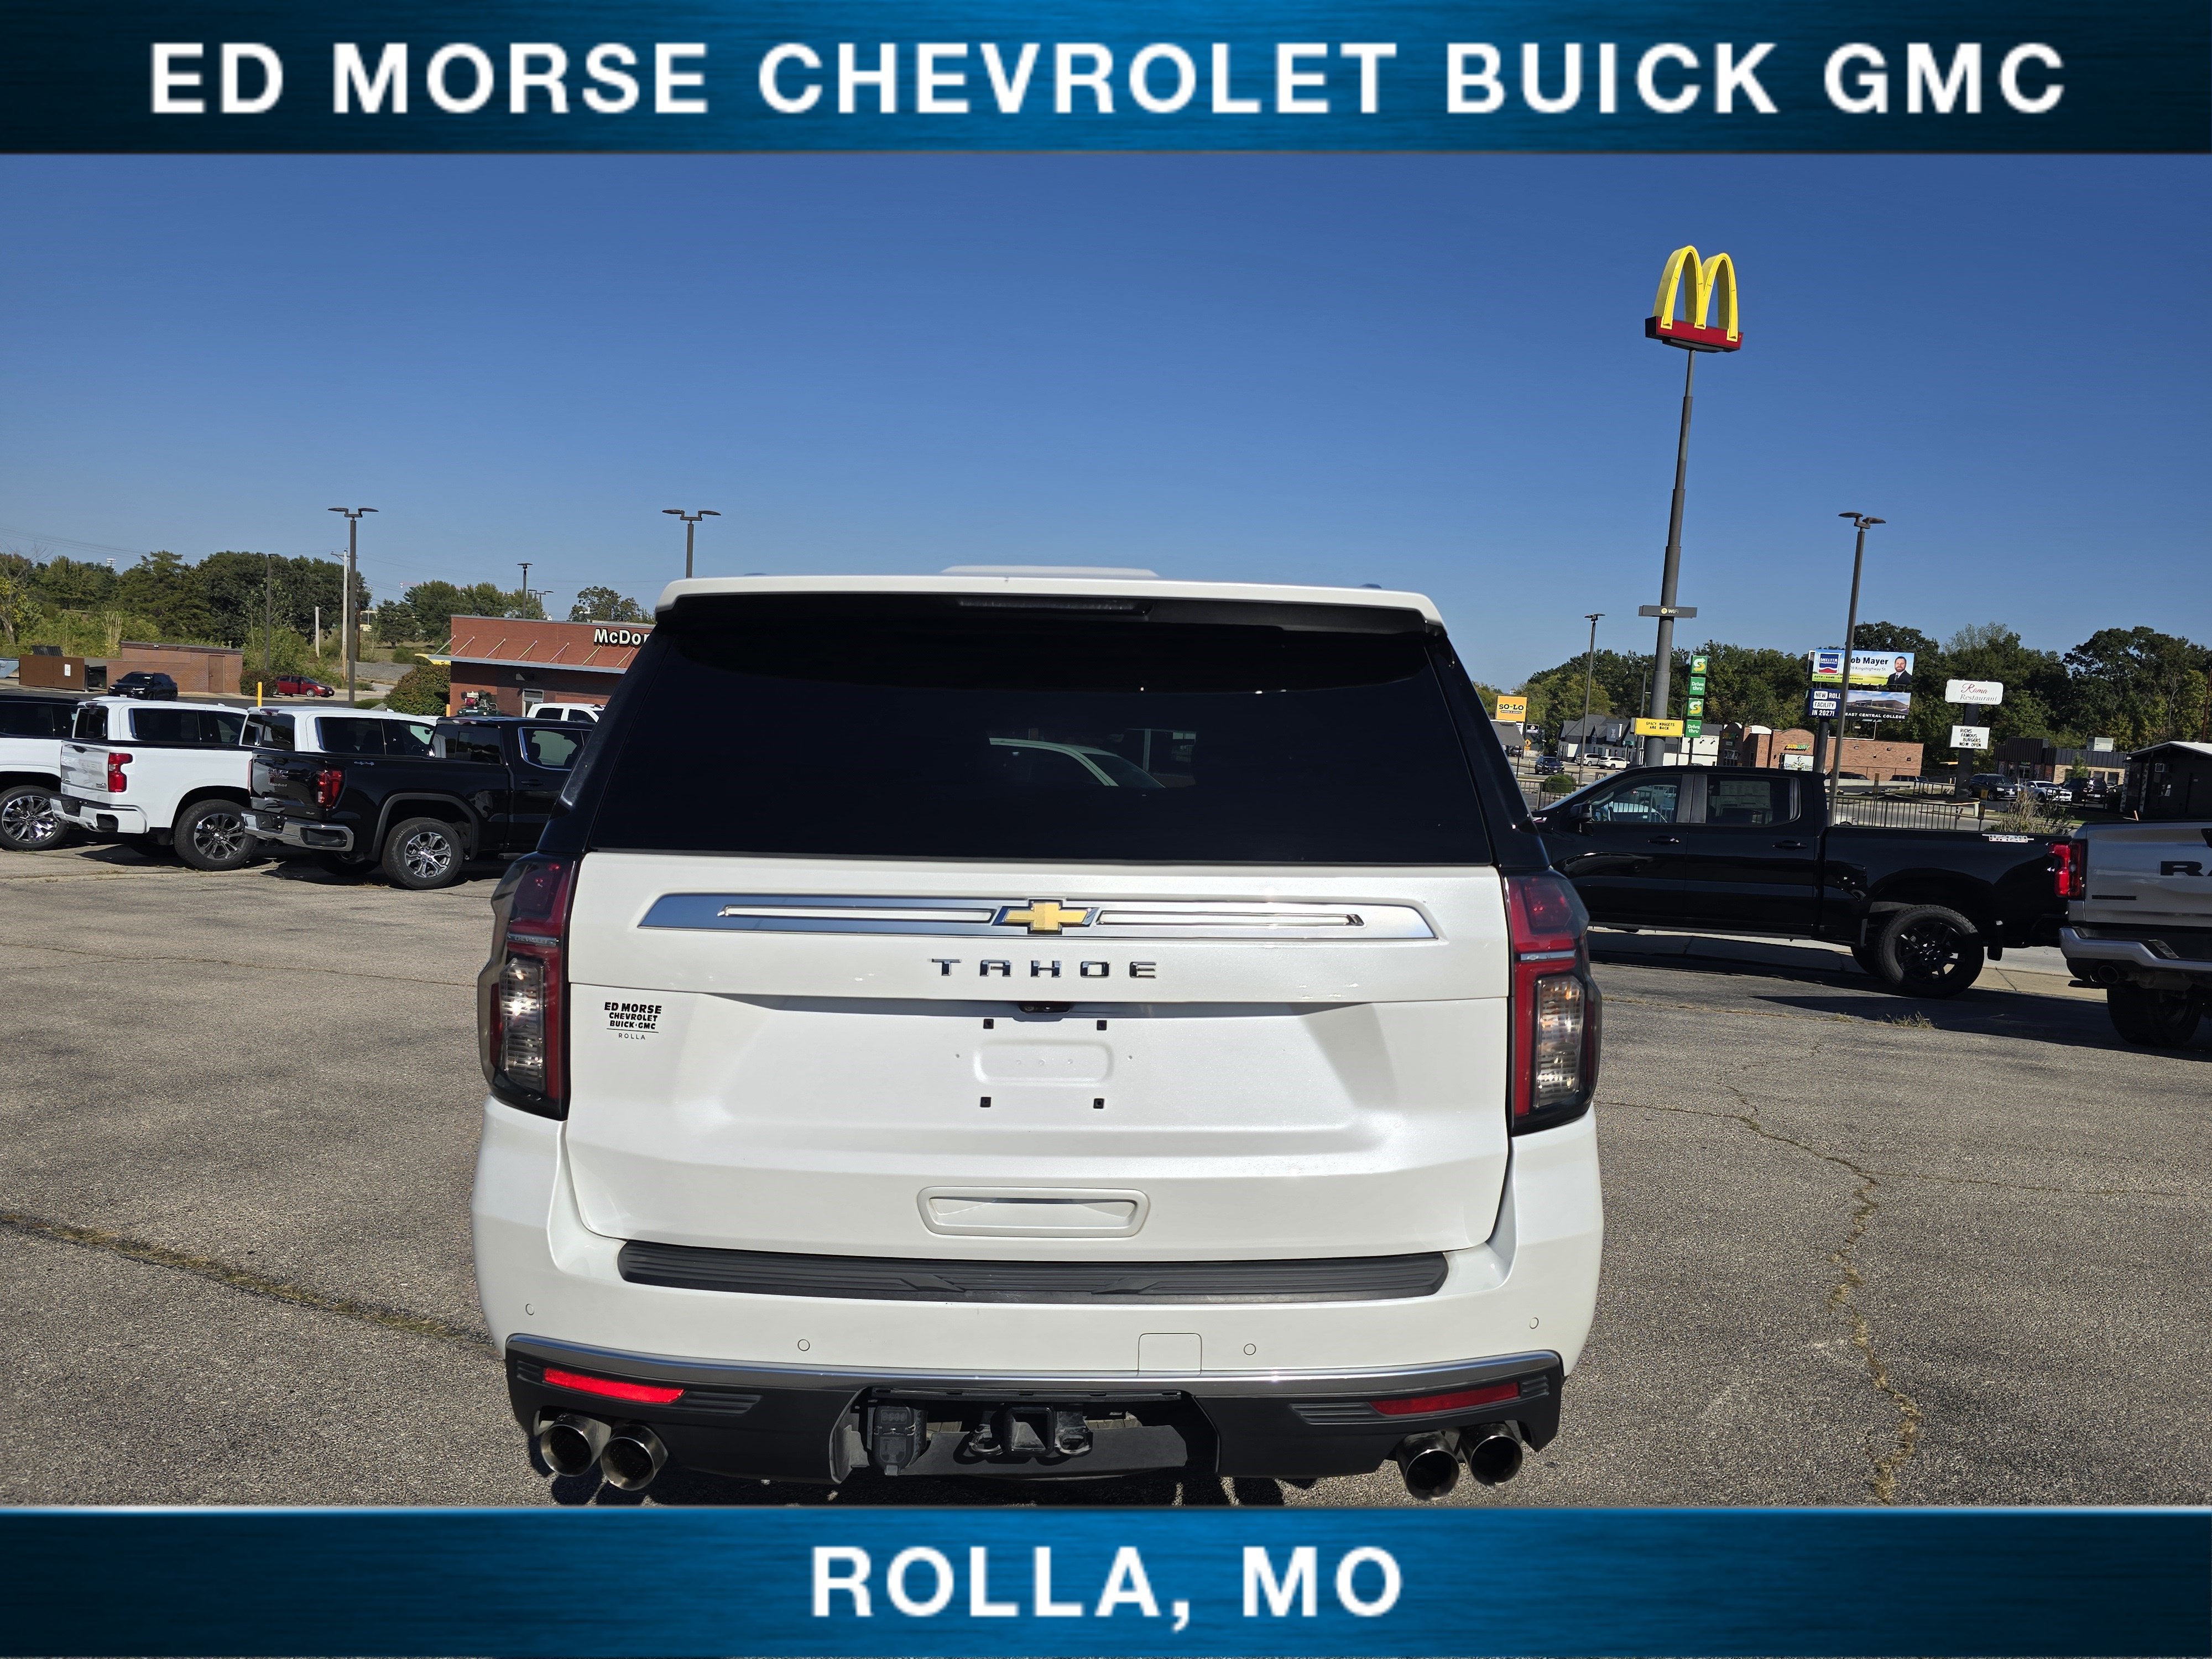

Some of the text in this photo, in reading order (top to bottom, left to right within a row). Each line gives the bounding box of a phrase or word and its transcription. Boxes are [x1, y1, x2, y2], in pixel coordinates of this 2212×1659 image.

[1863, 657, 1889, 666] Mayer
[931, 958, 1157, 978] TAHOE
[604, 1002, 662, 1014] ED MORSE
[609, 1012, 658, 1021] CHEVROLET
